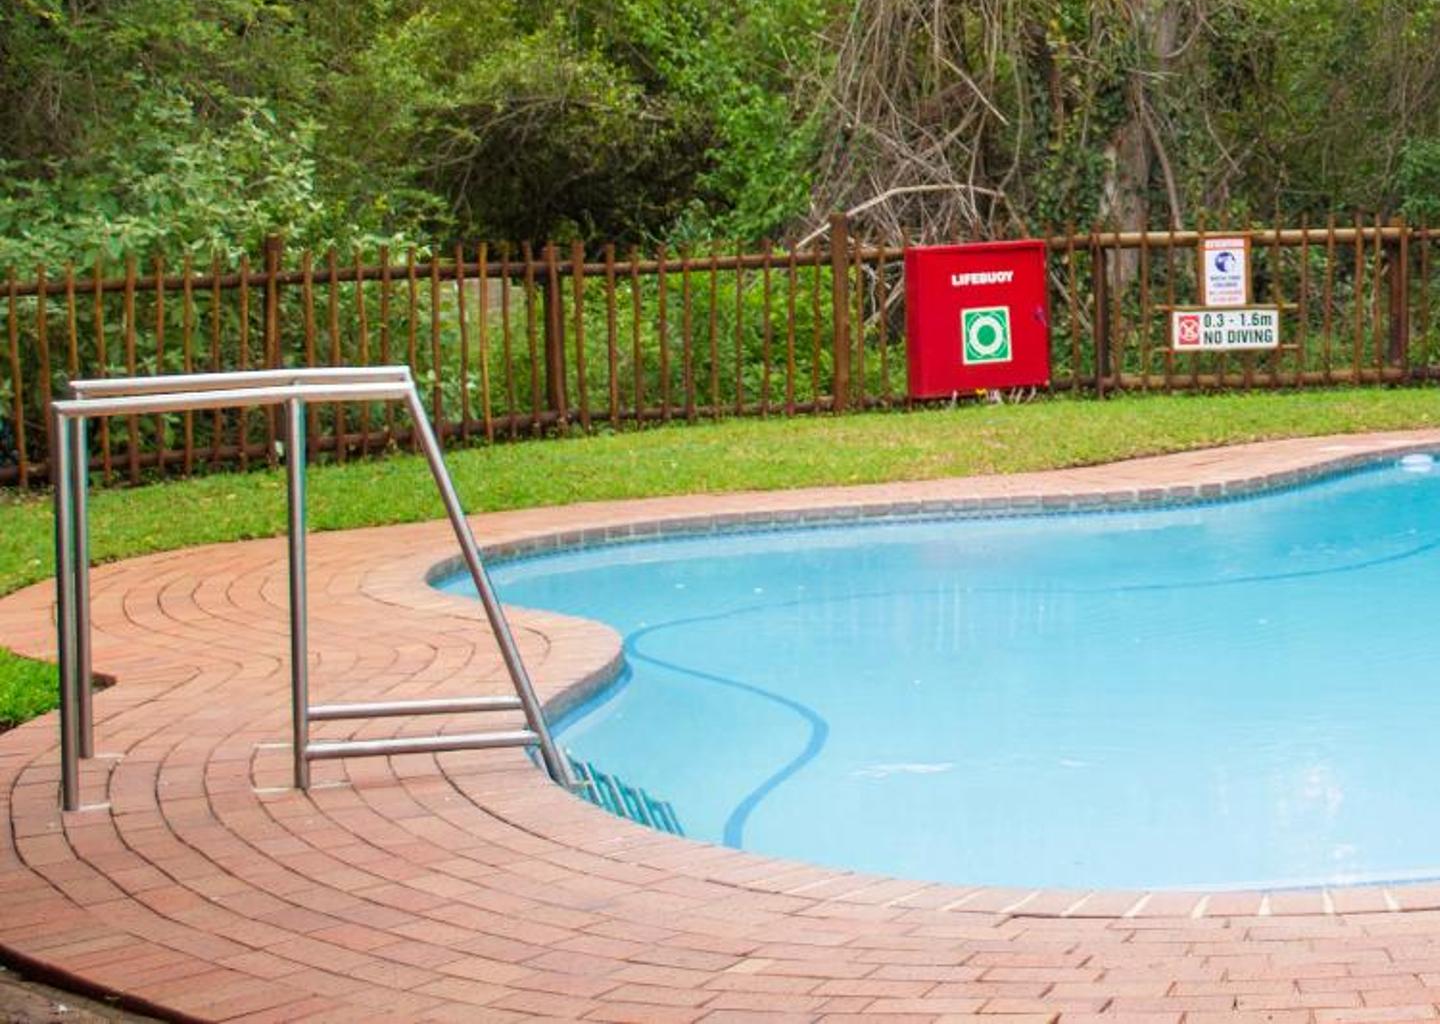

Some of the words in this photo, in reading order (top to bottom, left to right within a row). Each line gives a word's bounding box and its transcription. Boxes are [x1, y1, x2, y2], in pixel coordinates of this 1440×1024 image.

[952, 270, 1014, 286] LIFEBUOY
[1203, 313, 1225, 328] 0.3
[1203, 330, 1222, 344] NO
[1227, 328, 1273, 344] DIVING
